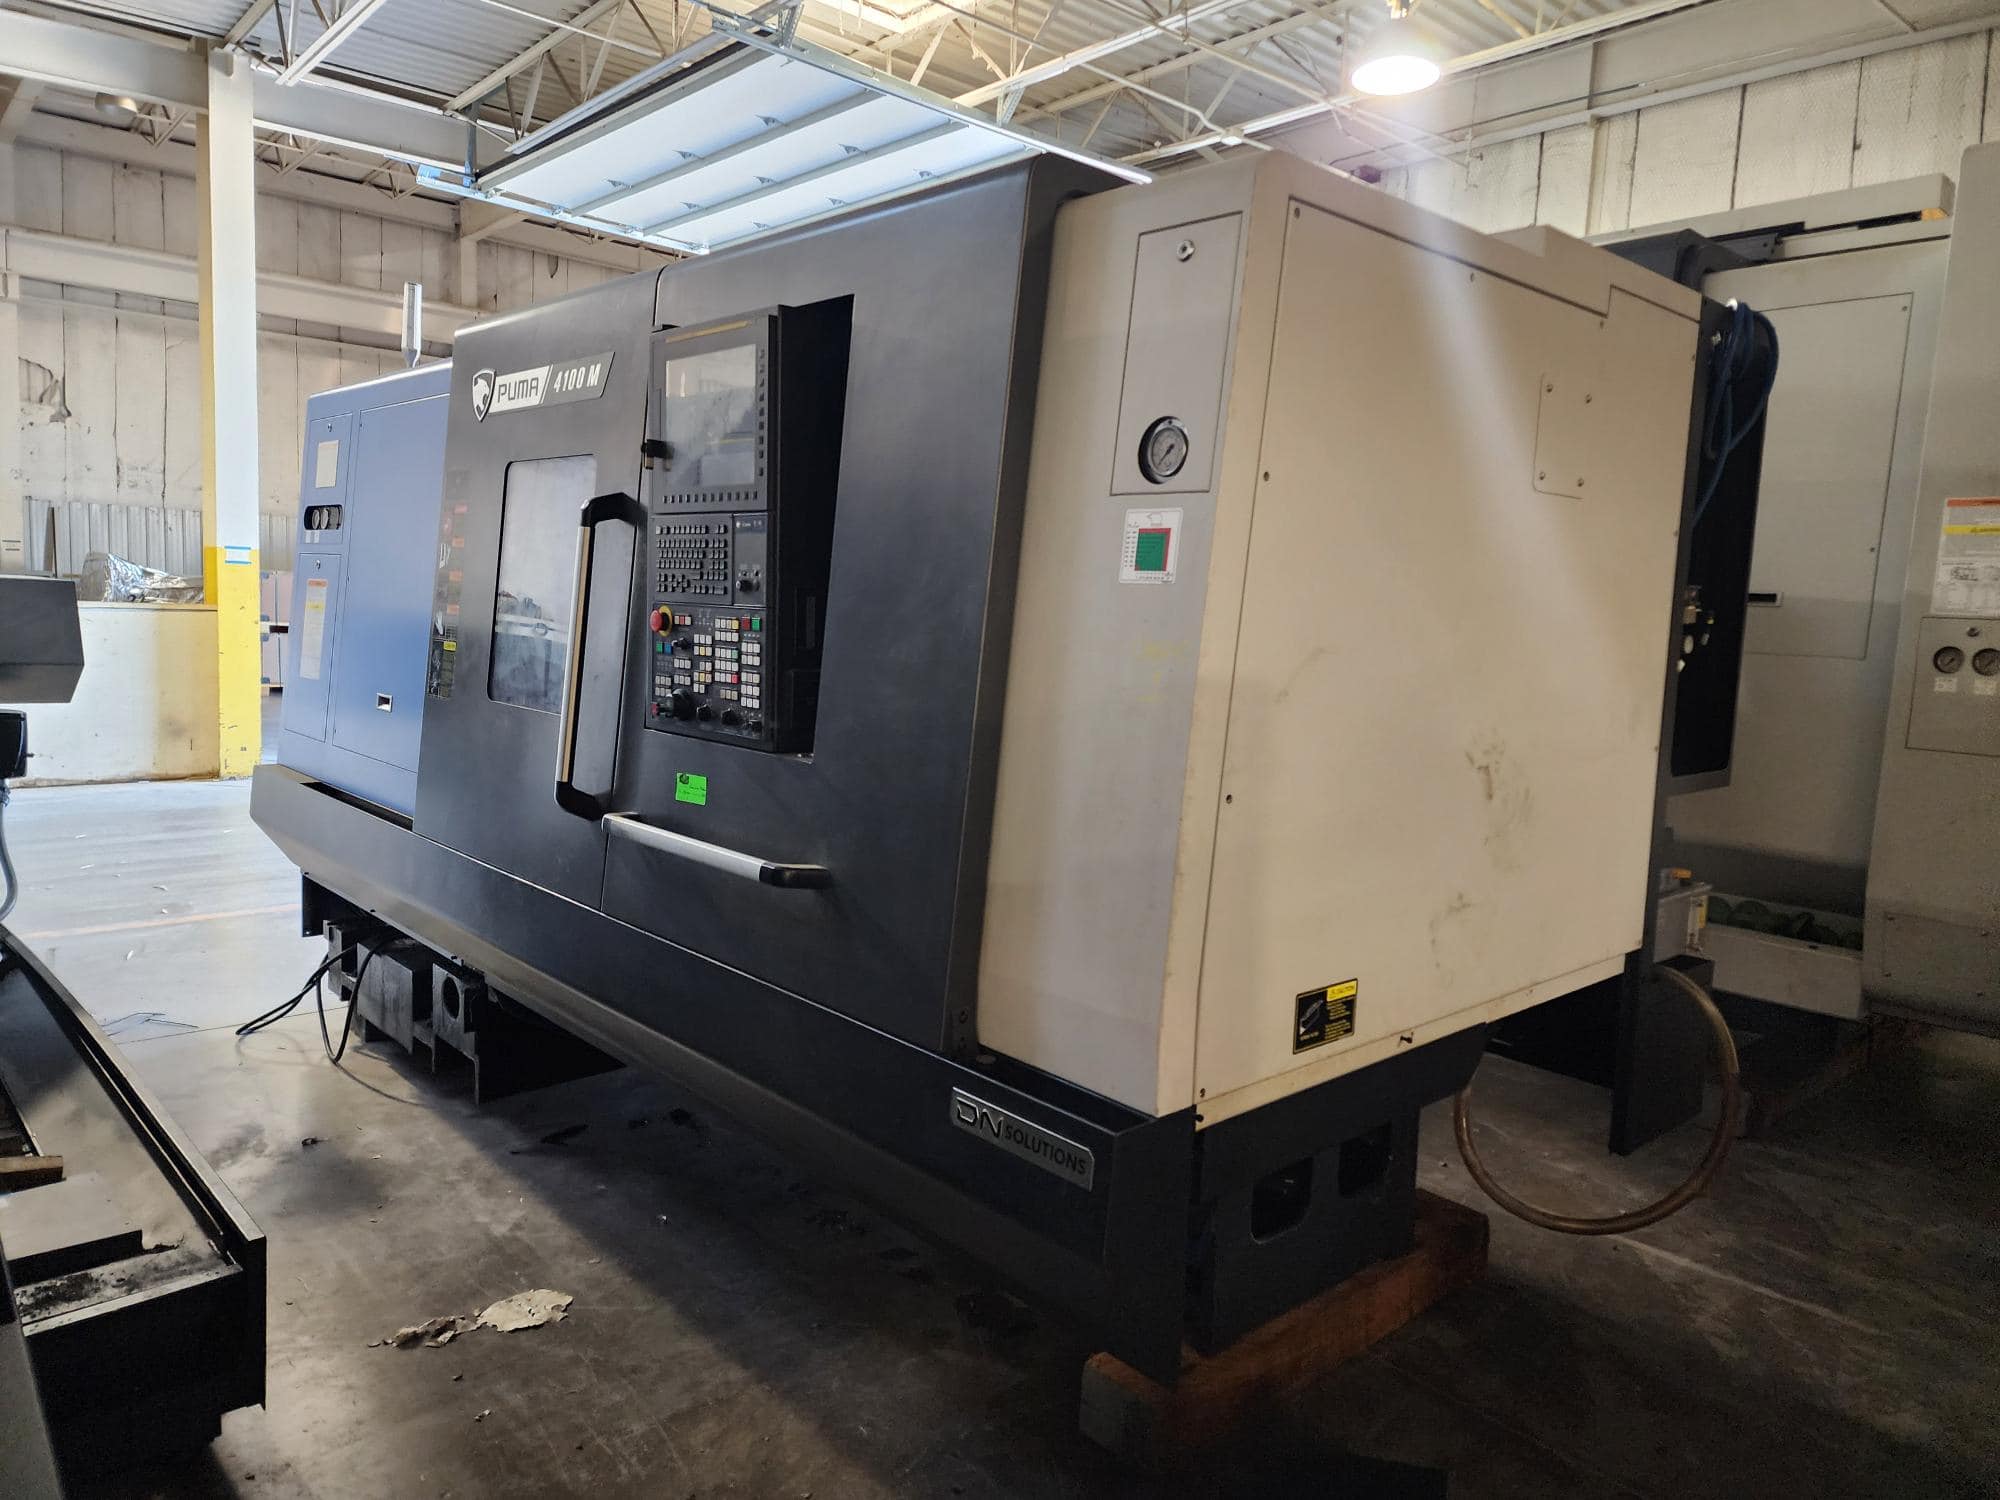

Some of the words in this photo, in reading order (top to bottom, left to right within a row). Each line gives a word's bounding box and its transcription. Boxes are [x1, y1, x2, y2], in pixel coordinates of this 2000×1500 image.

[497, 377, 540, 403] PUMA
[553, 366, 586, 393] 4100
[586, 363, 602, 387] M
[956, 1096, 1005, 1139] DN
[1005, 1126, 1087, 1175] SOLUTIONS
